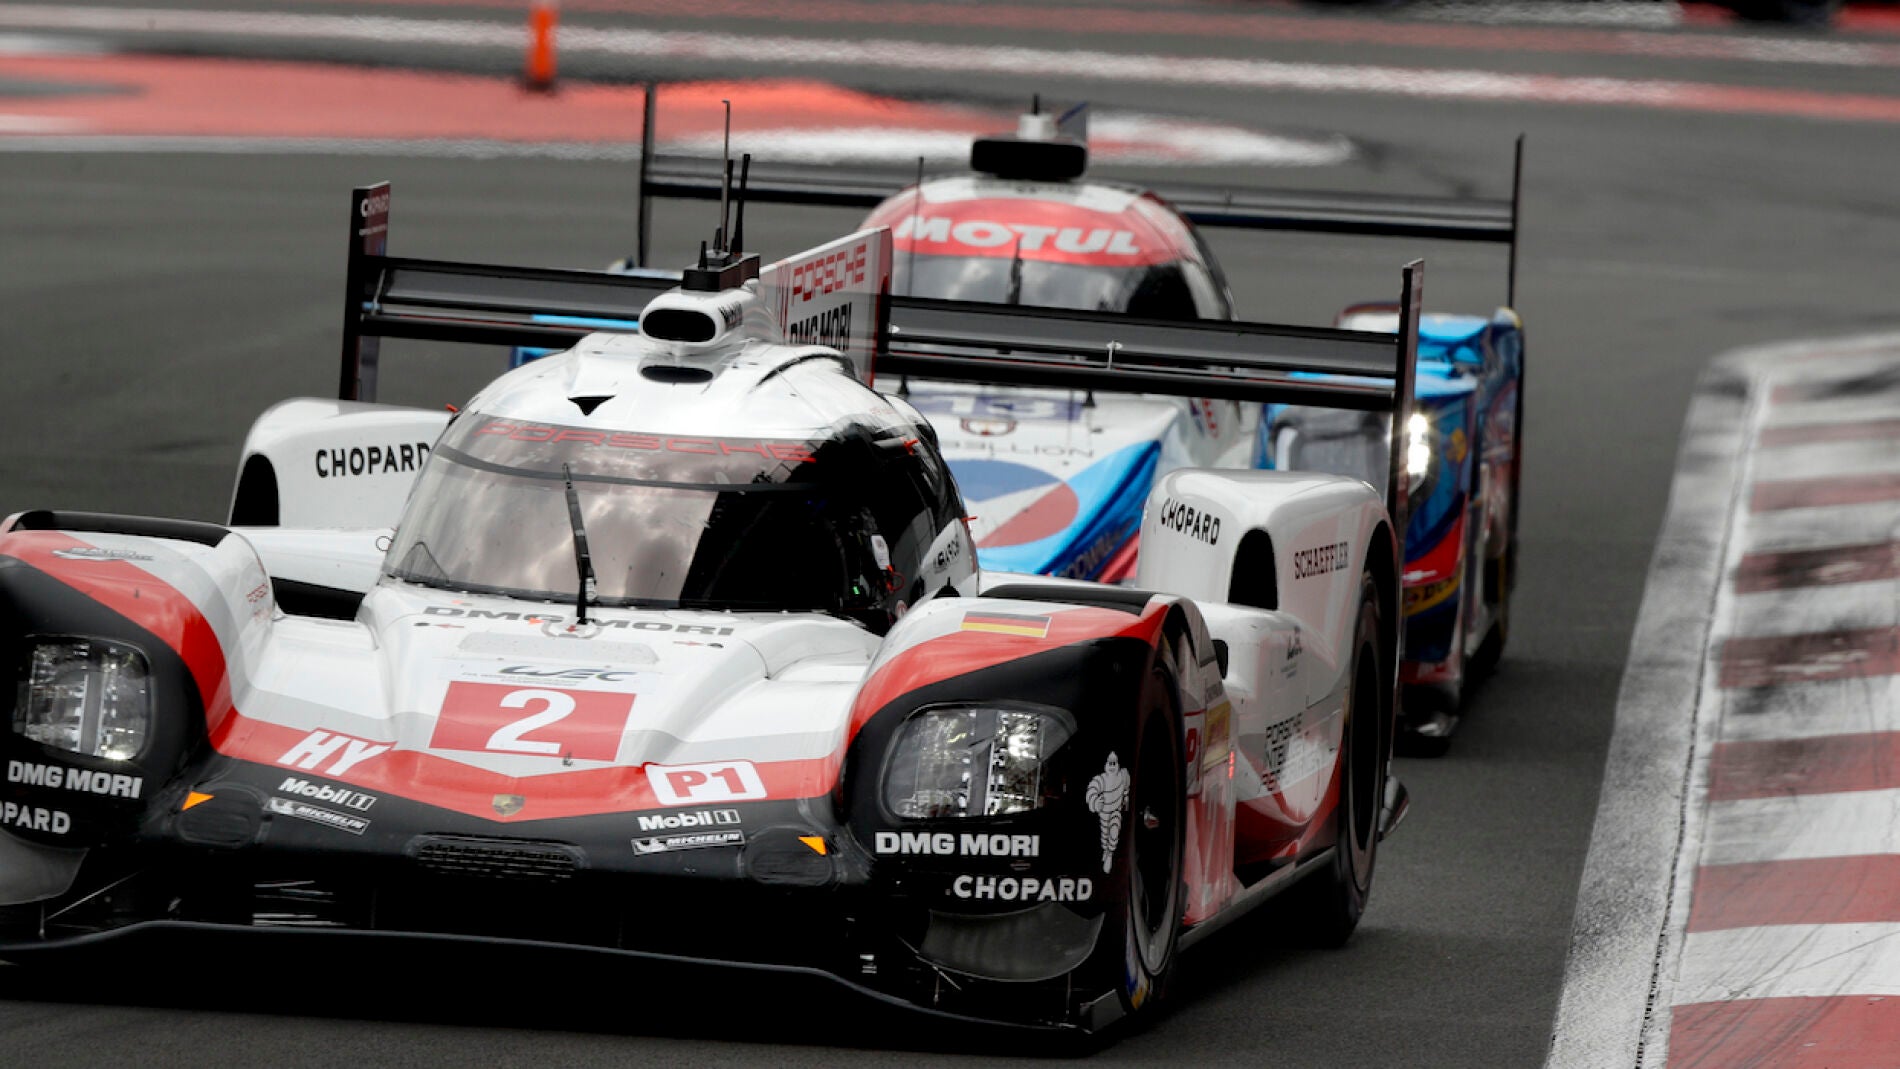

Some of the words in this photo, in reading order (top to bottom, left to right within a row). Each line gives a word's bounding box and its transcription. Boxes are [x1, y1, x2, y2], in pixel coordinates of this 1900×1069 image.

[894, 214, 1140, 255] MOTUL
[791, 243, 867, 306] PORSCHE
[819, 301, 852, 351] MORI
[473, 421, 817, 463] PORSCHE
[1160, 497, 1221, 546] CHOPARD
[1294, 541, 1349, 580] SCHAEFFLER
[422, 605, 564, 623] DMG
[583, 616, 735, 637] MORI
[499, 665, 638, 682] WEC
[485, 689, 577, 755] 2
[276, 728, 391, 777] HY
[8, 760, 63, 788] DMG
[65, 767, 143, 799] MORI
[278, 777, 353, 804] Mobil
[664, 767, 748, 798] P1
[0, 801, 71, 834] PARD
[296, 806, 366, 829] MICHELIN
[637, 810, 713, 831] Mobil
[665, 833, 740, 848] MICHELIN
[874, 831, 956, 855] DMG
[960, 834, 1040, 857] MORI
[953, 875, 1093, 902] CHOPARD
